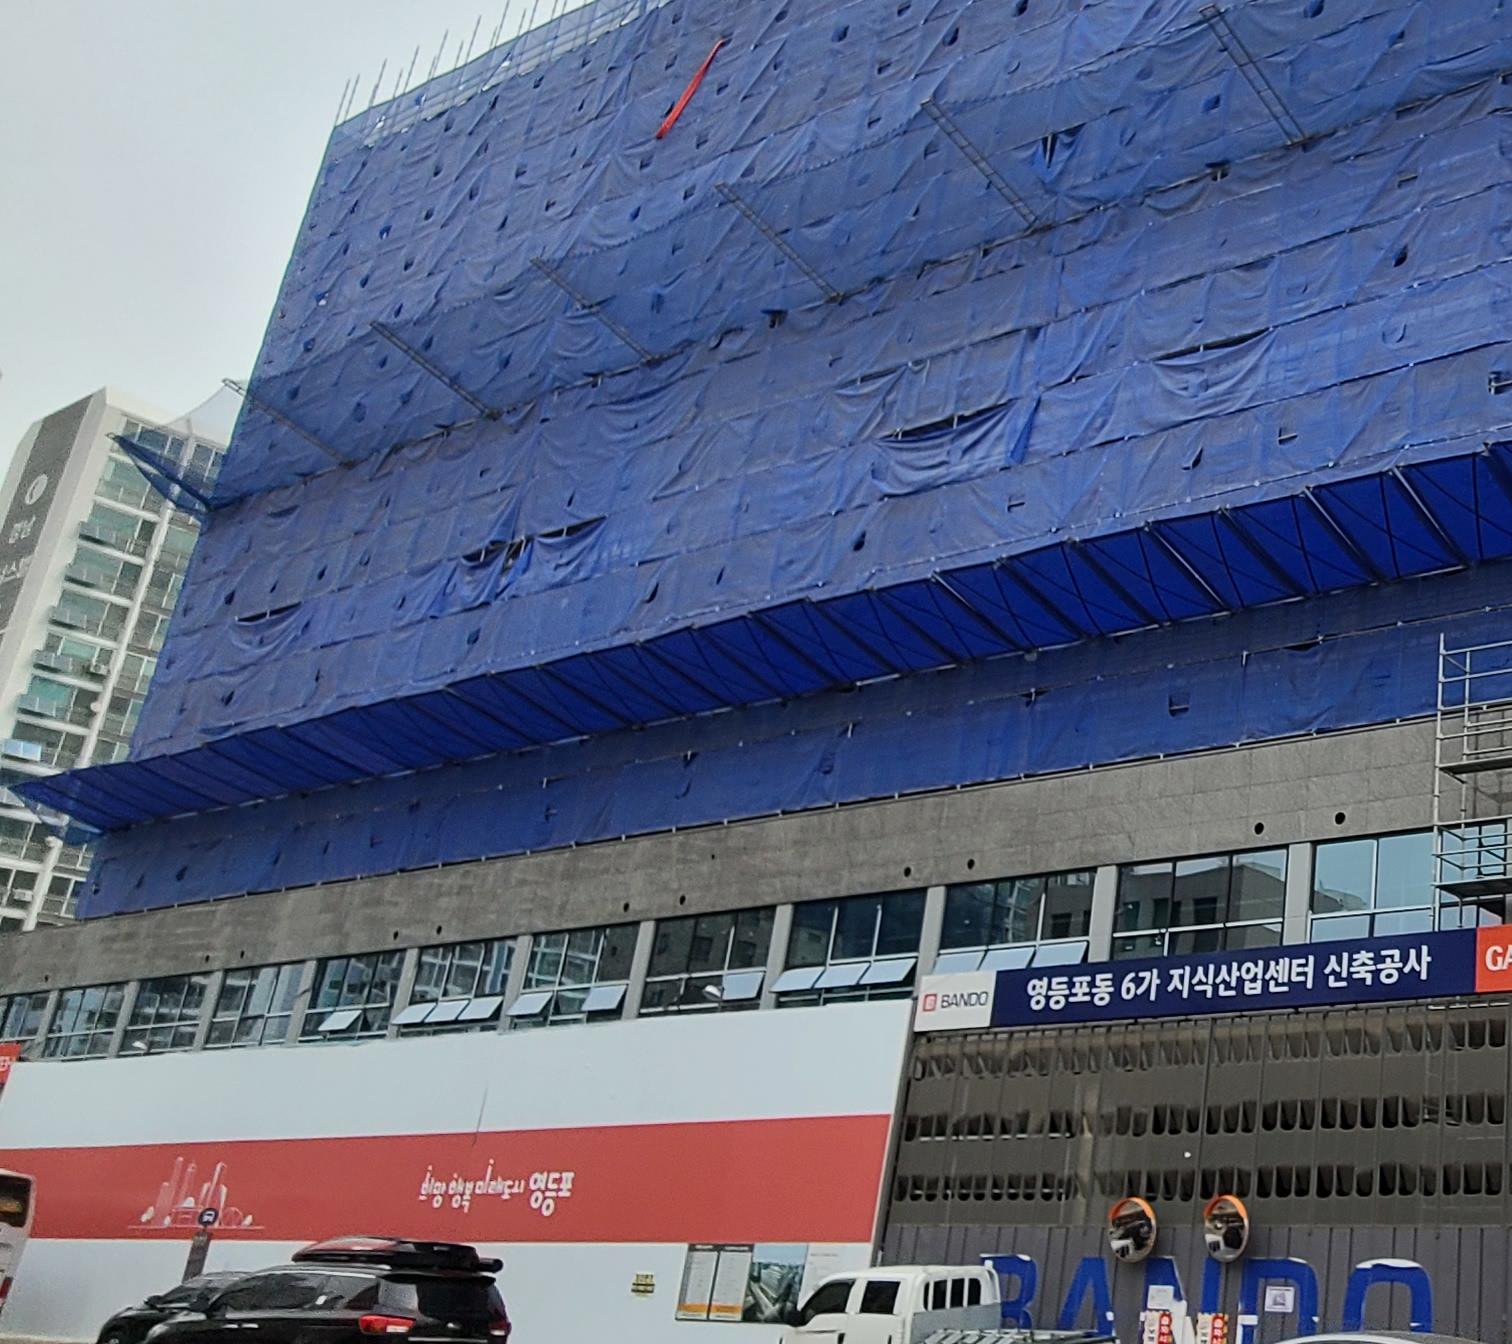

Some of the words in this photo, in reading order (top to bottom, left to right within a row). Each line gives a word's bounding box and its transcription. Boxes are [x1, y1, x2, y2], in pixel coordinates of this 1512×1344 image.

[940, 991, 989, 1009] BANDO
[1026, 972, 1115, 1011] 영등포동
[1120, 968, 1161, 1001] 6가
[1167, 954, 1315, 1000] 지식산업센터
[1323, 944, 1432, 988] 신축공사
[418, 1164, 446, 1209] 희망
[448, 1172, 474, 1213] 행복
[474, 1158, 526, 1200] 미래도시
[529, 1170, 575, 1217] 영등포
